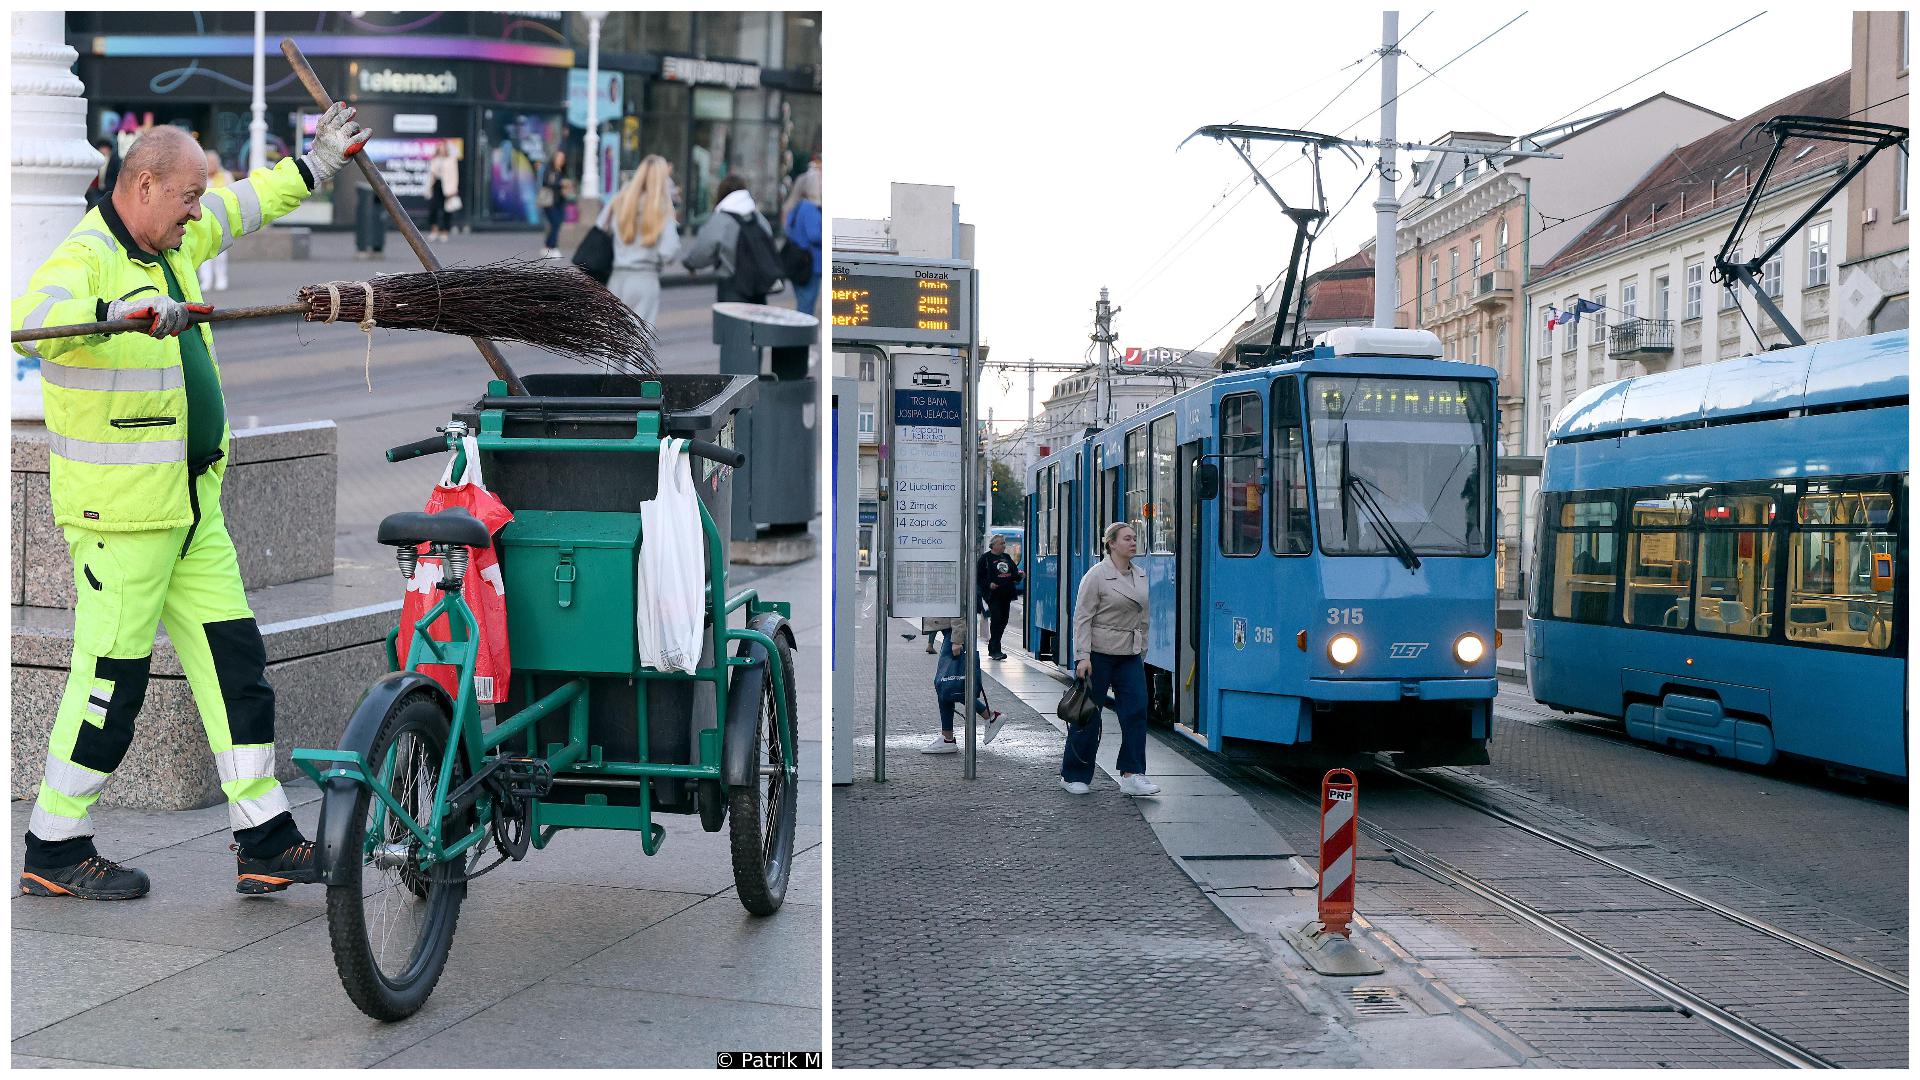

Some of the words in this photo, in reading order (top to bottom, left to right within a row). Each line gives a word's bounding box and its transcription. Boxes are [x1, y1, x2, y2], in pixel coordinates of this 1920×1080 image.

[359, 68, 458, 93] telemach
[915, 270, 949, 280] Dolazak
[1146, 350, 1183, 364] HPB
[911, 396, 926, 406] TRG
[927, 397, 948, 407] BANA
[898, 409, 923, 419] JOSIPA
[895, 480, 907, 492] 12
[896, 500, 907, 511] 13
[896, 517, 907, 528] 14
[898, 535, 909, 545] 17
[1327, 607, 1364, 625] 315
[1254, 626, 1273, 643] 315
[1389, 642, 1430, 659] ZET
[1330, 790, 1352, 800] PRP
